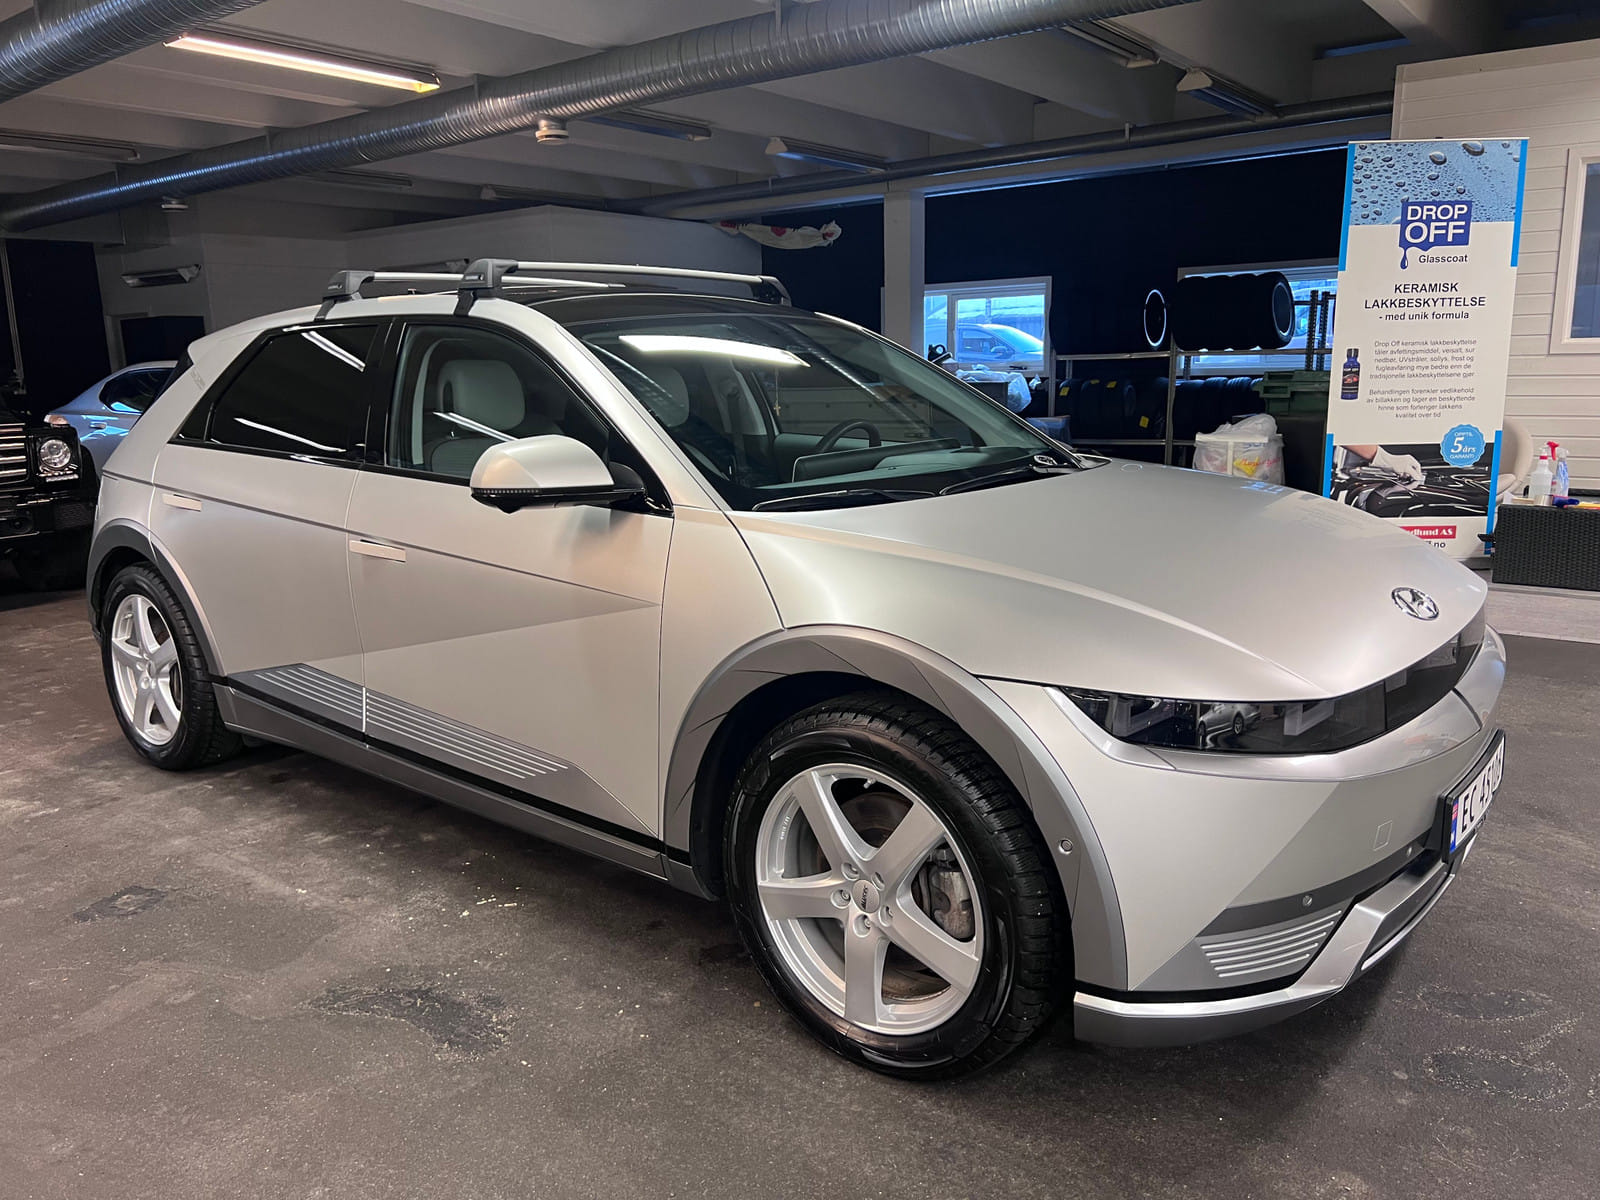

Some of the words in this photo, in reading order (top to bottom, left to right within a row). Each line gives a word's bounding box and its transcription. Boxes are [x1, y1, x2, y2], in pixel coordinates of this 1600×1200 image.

[1406, 204, 1468, 220] DROP
[1404, 221, 1466, 243] OFF
[1418, 254, 1468, 264] Glasscoat
[1394, 282, 1459, 293] KERAMISK
[1364, 296, 1486, 309] LAKKBESKYTTELSE
[1385, 312, 1405, 320] med
[1408, 311, 1429, 320] unik
[1432, 310, 1469, 320] formula
[1451, 436, 1464, 453] 5
[1410, 528, 1439, 536] dlund
[1440, 528, 1453, 536] AS
[1461, 784, 1477, 833] EC
